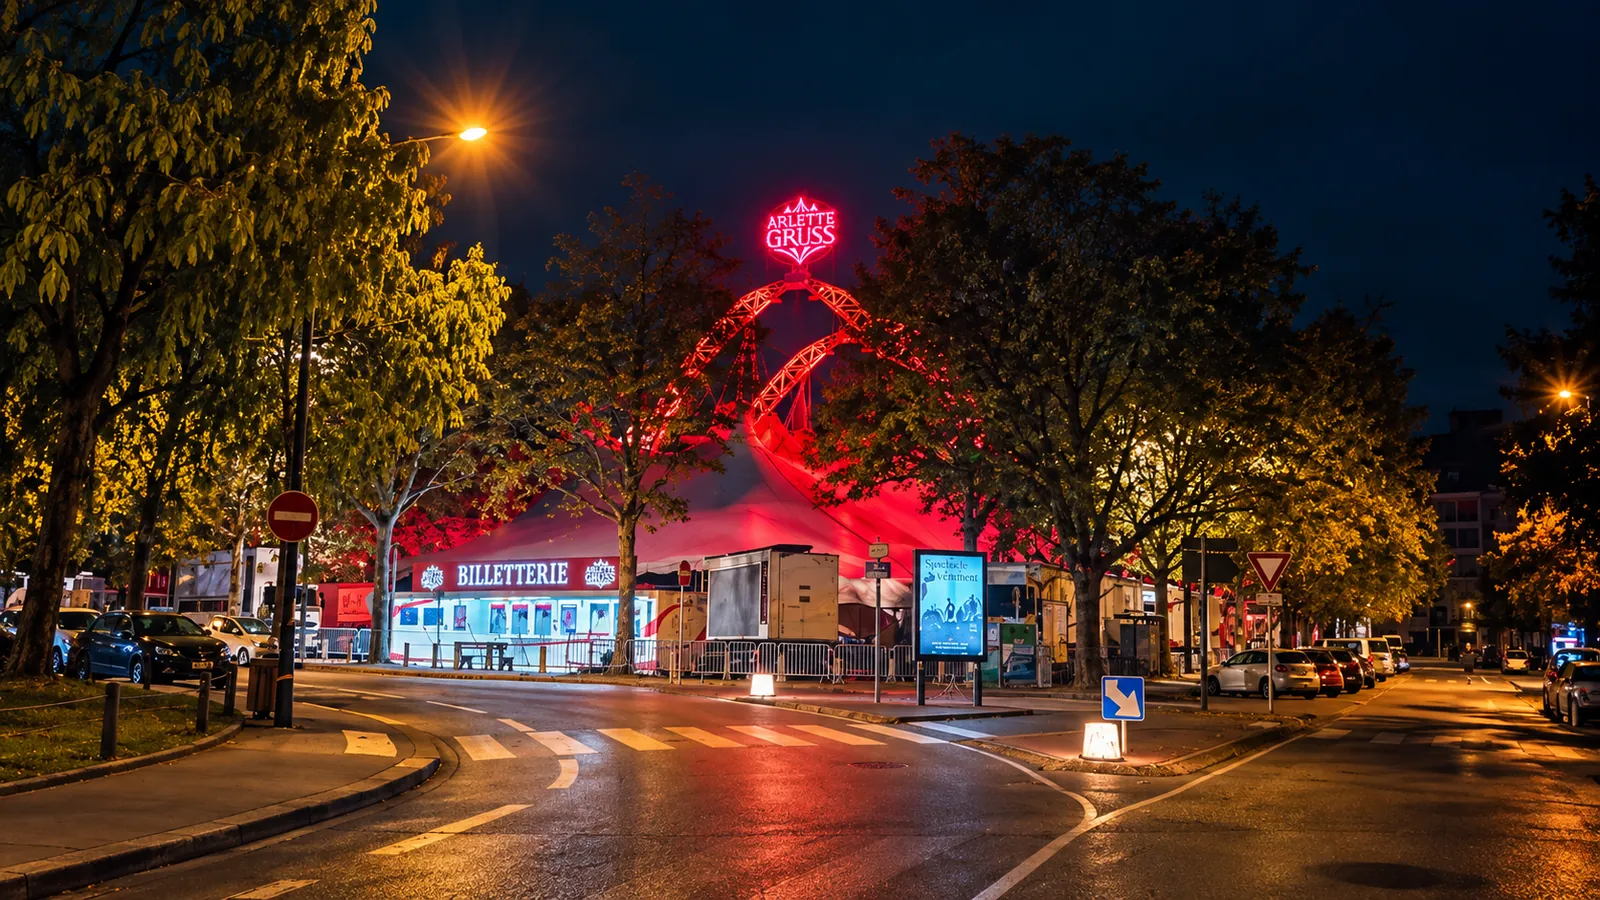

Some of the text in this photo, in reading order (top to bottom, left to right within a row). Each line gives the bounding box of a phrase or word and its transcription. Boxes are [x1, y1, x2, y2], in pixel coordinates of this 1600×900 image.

[767, 211, 835, 229] ARLETTE
[766, 225, 836, 248] GRUSS
[457, 562, 569, 586] BILLETTERIE
